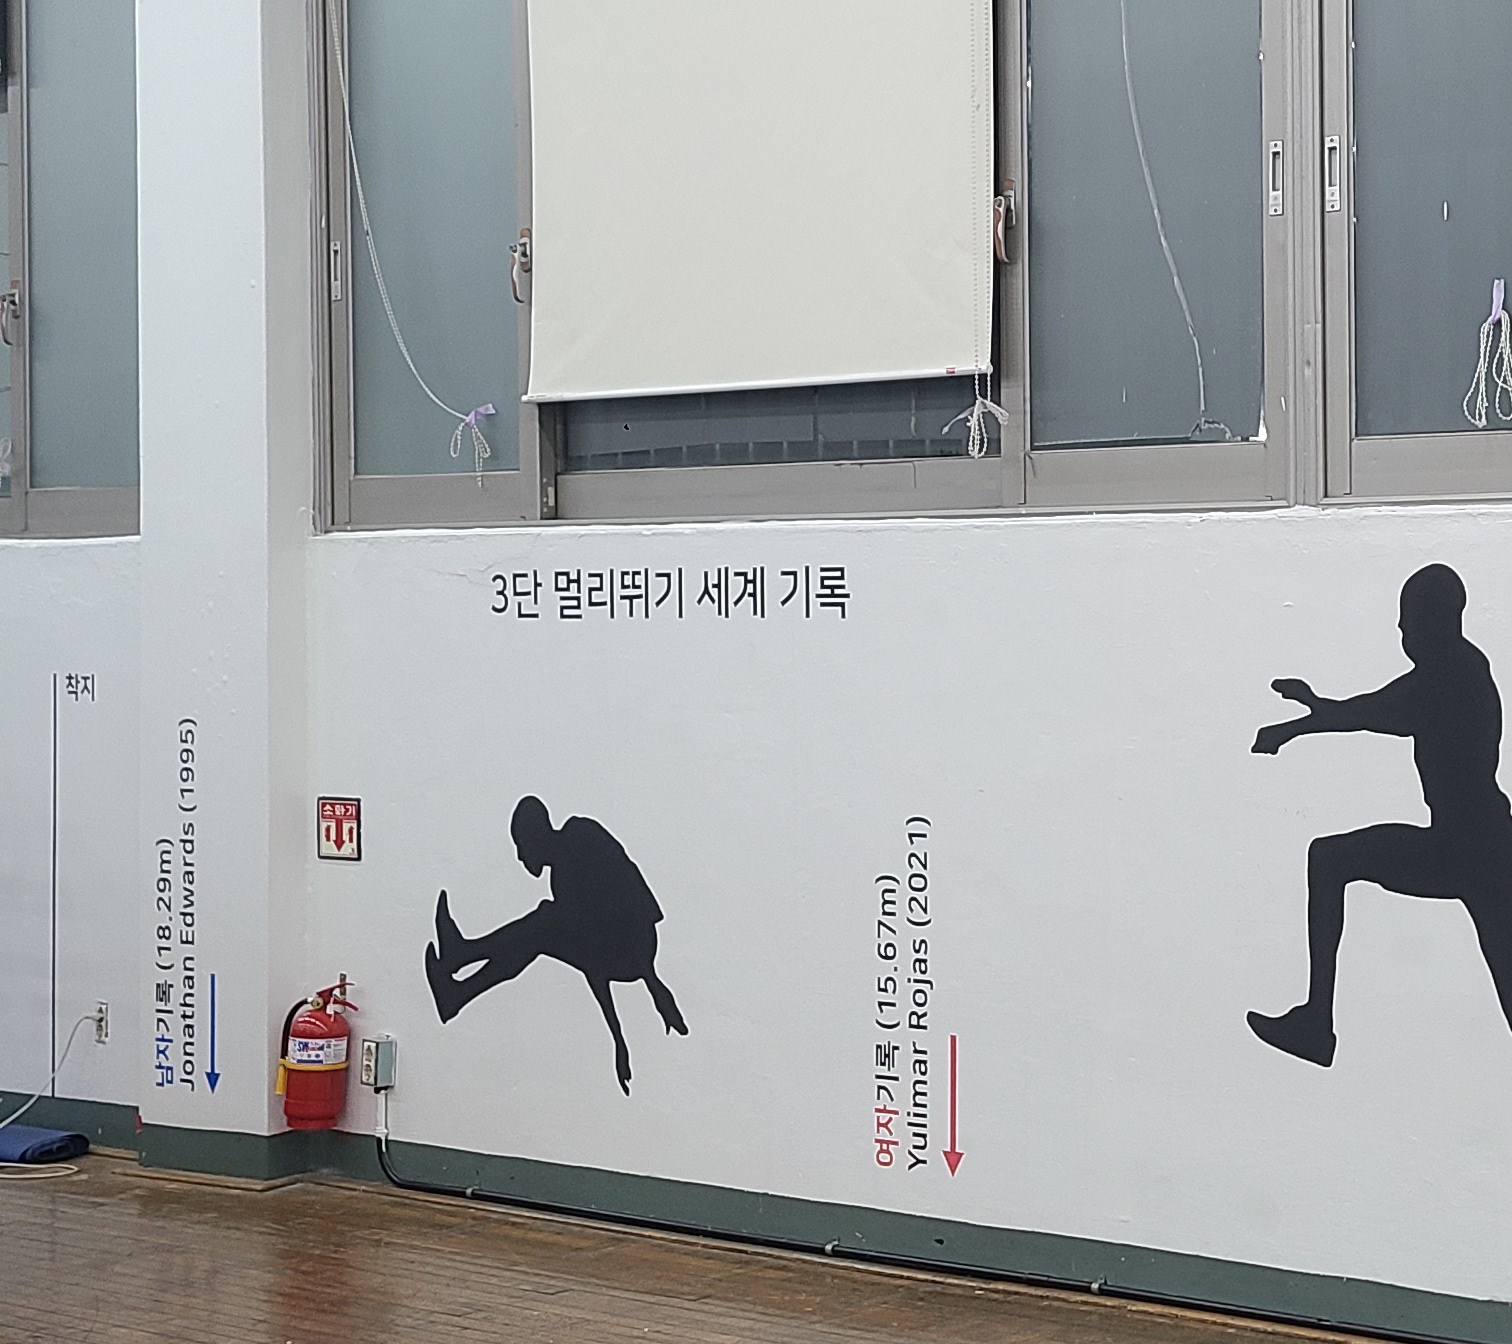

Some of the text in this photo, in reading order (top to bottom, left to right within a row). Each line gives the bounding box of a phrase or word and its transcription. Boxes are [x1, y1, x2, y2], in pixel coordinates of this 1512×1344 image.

[65, 672, 95, 702] 착지
[490, 564, 852, 621] 3단 멀리뛰기 세계 기록
[177, 717, 198, 1093] Jonathan Edwards (1995)
[322, 803, 357, 816] 소화기
[154, 838, 175, 1088] 남자기록 (18.29m)
[873, 873, 901, 1168] 여자기록 (15.67m)
[904, 815, 935, 1172] Yulimar Rojas (2021)
